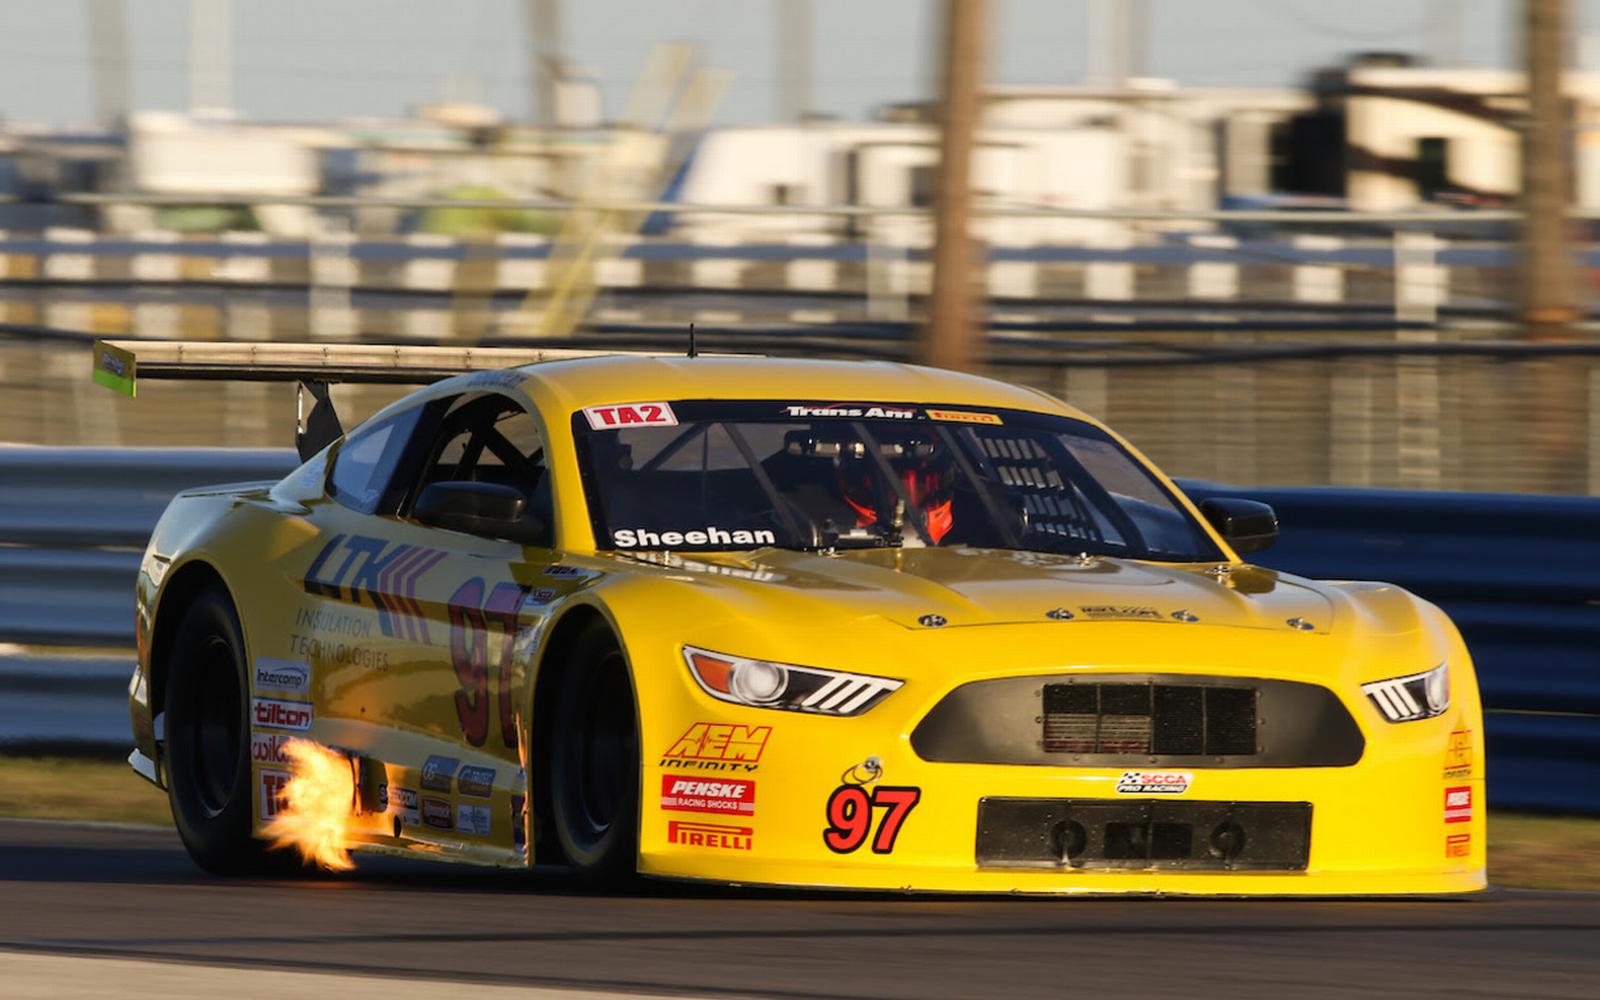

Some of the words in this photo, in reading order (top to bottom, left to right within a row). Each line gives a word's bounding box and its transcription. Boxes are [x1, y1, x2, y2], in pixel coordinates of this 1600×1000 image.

[592, 405, 667, 425] TA2
[786, 406, 862, 418] Trans
[863, 407, 914, 419] Am
[614, 527, 776, 547] Sheehan
[303, 533, 408, 637] LTK
[296, 607, 371, 638] INSULATION
[290, 634, 389, 672] TECHNOLOGIES
[447, 576, 530, 747] 97
[254, 702, 310, 726] tilton
[663, 722, 773, 762] AEM
[670, 781, 747, 798] PENSKE
[1141, 775, 1187, 784] SCCA
[677, 798, 706, 807] RACING
[707, 799, 738, 809] SHOCKS
[823, 784, 921, 854] 97
[668, 820, 753, 850] PIRELLI
